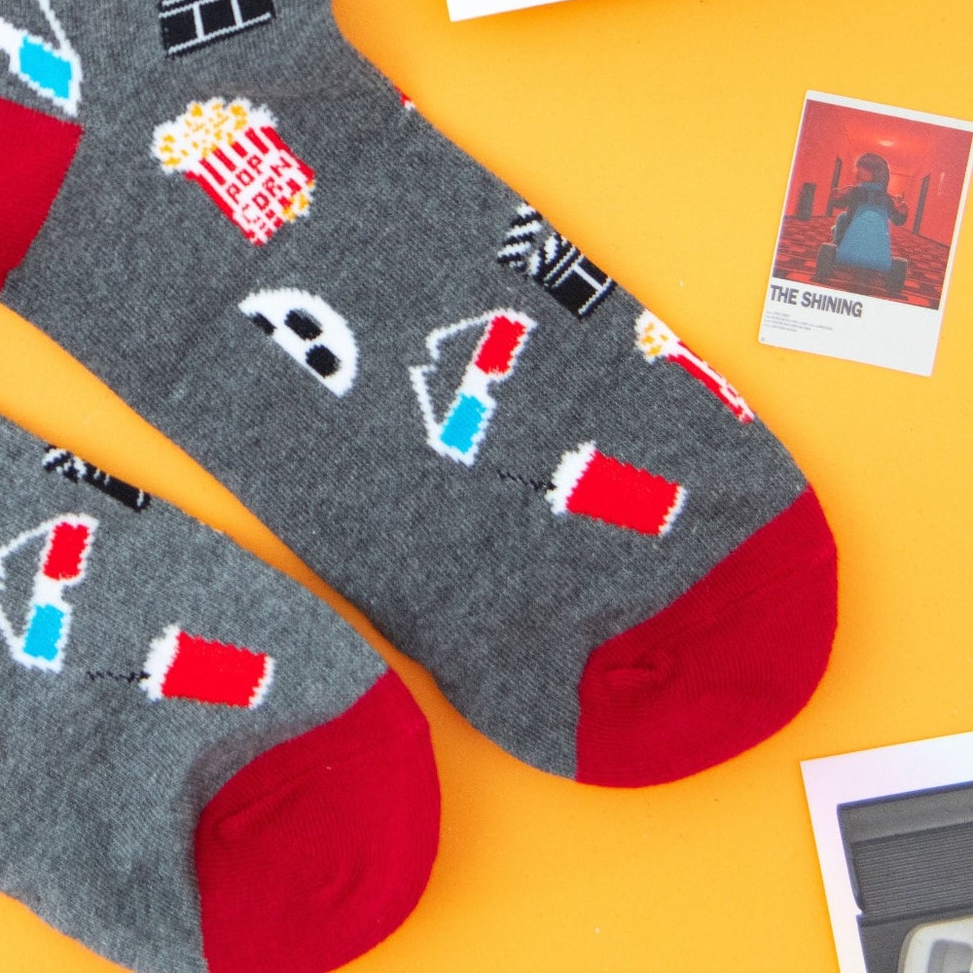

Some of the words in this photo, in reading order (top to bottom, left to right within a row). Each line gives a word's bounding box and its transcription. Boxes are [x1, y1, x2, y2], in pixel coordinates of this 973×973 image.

[226, 155, 262, 205] POP
[242, 156, 292, 224] CORN
[770, 284, 799, 306] THE
[801, 289, 863, 319] SHINING
